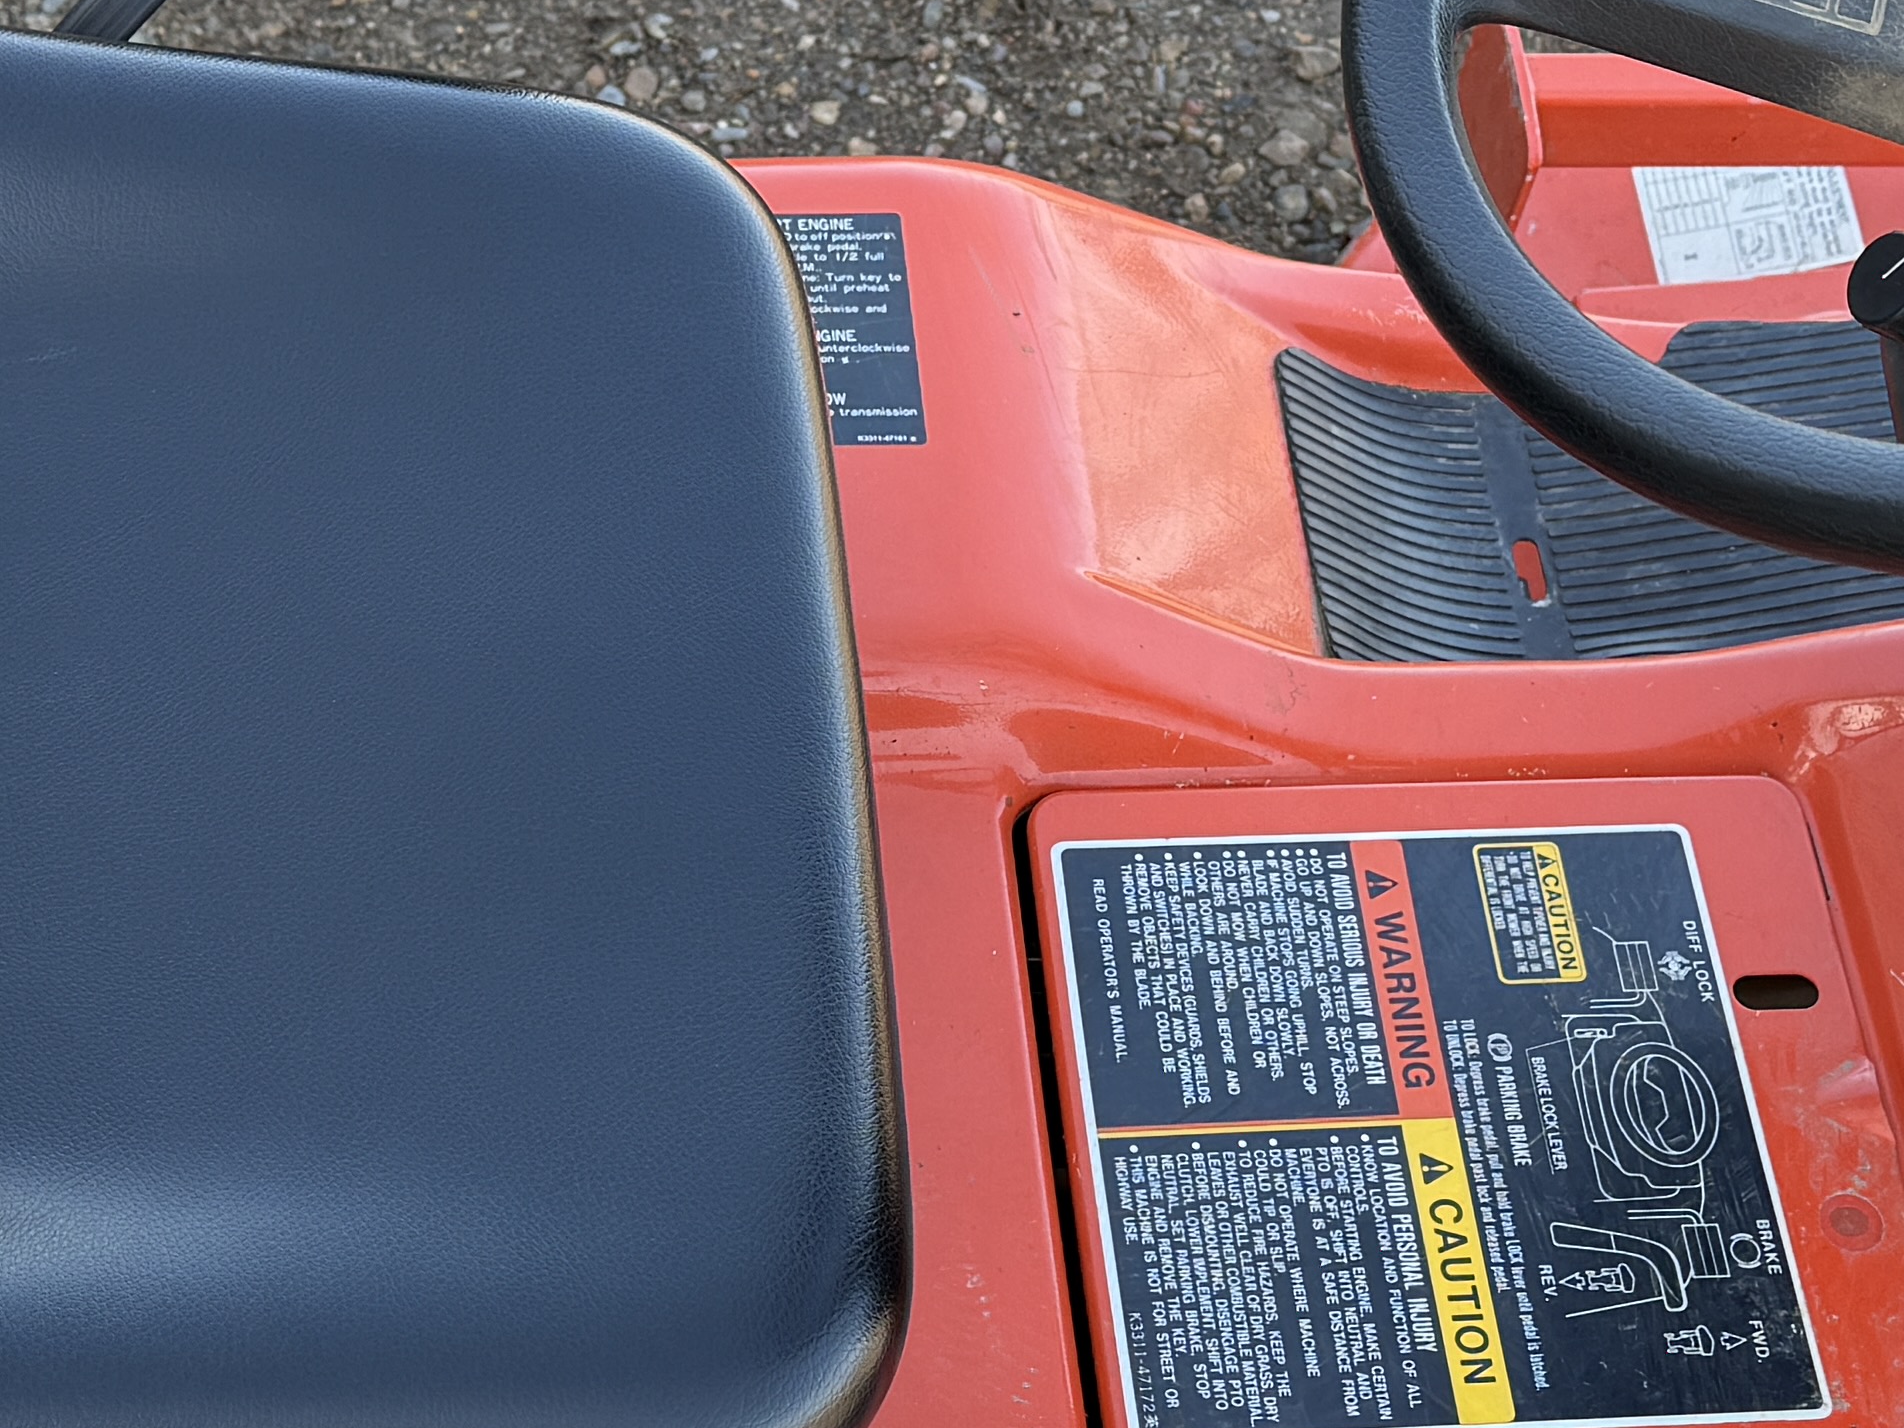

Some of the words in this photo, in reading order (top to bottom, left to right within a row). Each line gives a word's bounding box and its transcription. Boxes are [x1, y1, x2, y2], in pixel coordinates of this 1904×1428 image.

[795, 233, 807, 241] to
[811, 233, 827, 241] off
[798, 219, 854, 231] ENGINE
[828, 243, 862, 252] pedal.
[836, 253, 858, 261] 1/2
[865, 252, 884, 260] full
[810, 284, 837, 292] until
[844, 284, 889, 293] preheat
[825, 273, 854, 282] Turn
[860, 273, 881, 283] key
[866, 304, 887, 313] and
[840, 406, 917, 416] transmission
[1250, 859, 1268, 896] BLADE
[1265, 858, 1279, 869] IF
[1280, 858, 1297, 892] AVOID
[1294, 857, 1309, 876] GO
[1308, 857, 1323, 875] DO
[1325, 851, 1347, 869] TO
[1268, 871, 1288, 923] MACHINE
[1298, 880, 1313, 897] UP
[1312, 879, 1329, 904] NOT
[1329, 873, 1354, 910] AVOID
[1257, 900, 1273, 925] AND
[1286, 896, 1305, 944] SUDDEN
[1302, 901, 1318, 926] AND
[1541, 873, 1577, 970] CAUTION
[1262, 928, 1279, 961] BACK
[1276, 927, 1295, 967] STOPS
[1306, 930, 1324, 967] DOWN
[1318, 908, 1339, 961] OPERATE
[1336, 914, 1364, 967] SERIOUS
[1682, 919, 1702, 953] DIFF
[1092, 878, 1108, 912] READ
[1108, 1004, 1127, 1063] MANUAL.
[1268, 965, 1286, 1002] DOWN
[1283, 969, 1302, 1008] GOING
[1327, 964, 1342, 983] ON
[1691, 960, 1715, 1002] LOCK
[1331, 985, 1350, 1023] STEEP
[1347, 972, 1373, 1016] INJURY
[1374, 912, 1435, 1088] WARNING
[1275, 1007, 1295, 1059] SLOWLY.
[1323, 1025, 1340, 1051] NOT
[1355, 1021, 1378, 1040] OR
[1338, 1026, 1359, 1076] SLOPES.
[1359, 1044, 1386, 1085] DEATH
[1299, 1061, 1317, 1095] STOP
[1329, 1056, 1349, 1109] ACROSS.
[1494, 1065, 1522, 1120] PARKING
[1530, 1056, 1552, 1095] BRAKE
[1539, 1096, 1559, 1130] LOCK
[1360, 1144, 1379, 1183] KNOW
[1376, 1135, 1399, 1156] TO
[1506, 1124, 1532, 1166] BRAKE
[1546, 1131, 1568, 1170] LEVER
[1380, 1162, 1408, 1207] AVOID
[1368, 1188, 1392, 1251] LOCATION
[1391, 1213, 1423, 1290] PERSONAL
[1755, 1218, 1782, 1274] BRAKE
[1381, 1256, 1398, 1284] AND
[1537, 1264, 1558, 1302] REV.
[1429, 1198, 1495, 1384] CAUTION
[1388, 1288, 1411, 1354] FUNCTION
[1406, 1297, 1437, 1352] INJURY
[1748, 1319, 1769, 1363] FWD.
[1401, 1359, 1417, 1378] OF
[1405, 1383, 1422, 1408] ALL
